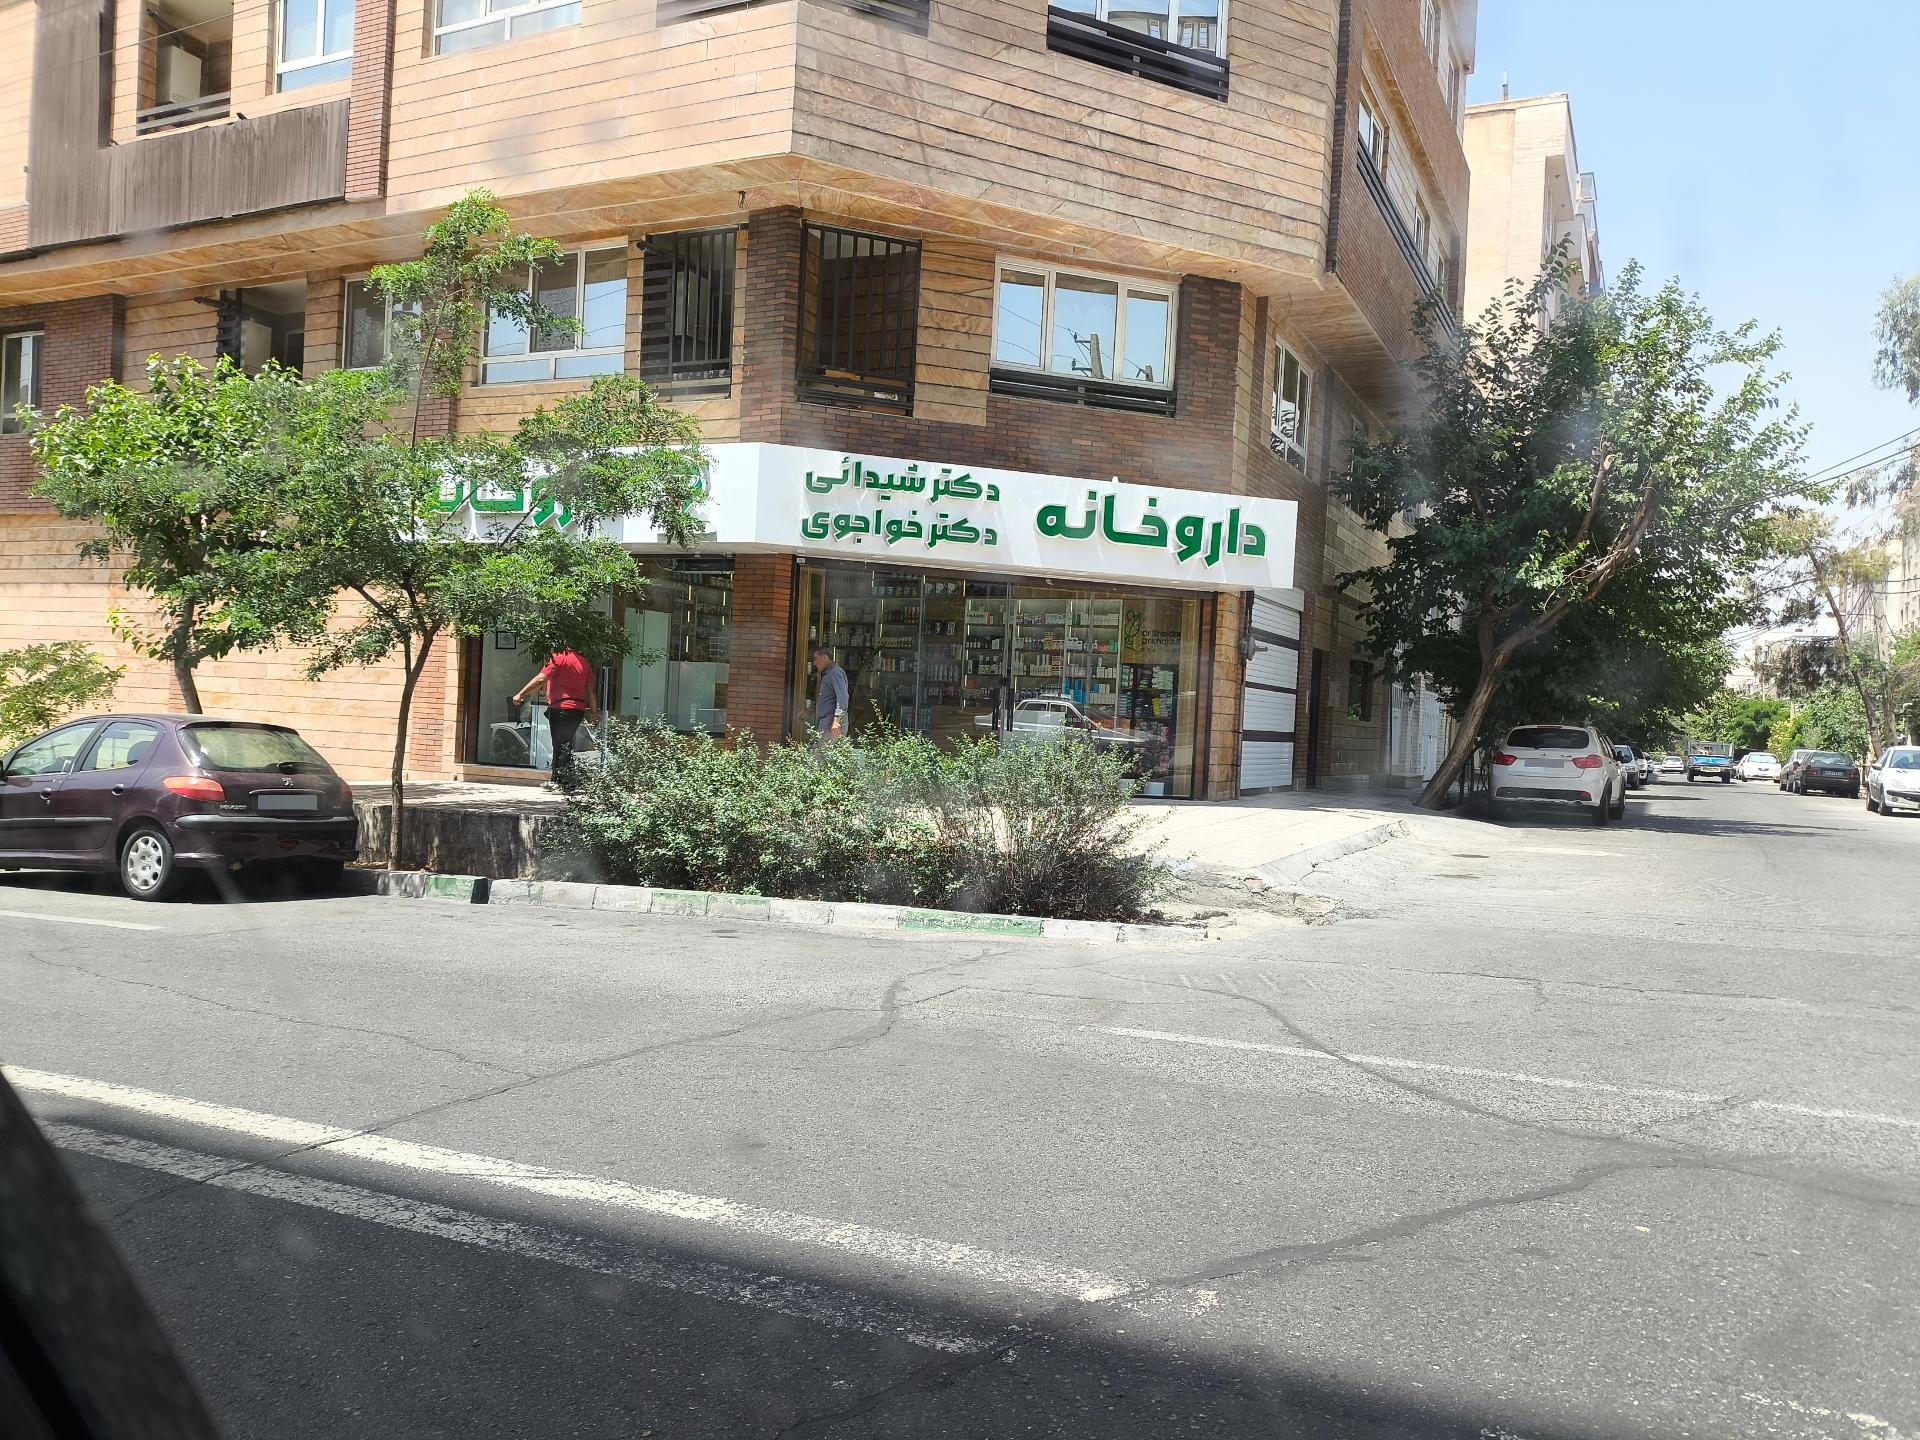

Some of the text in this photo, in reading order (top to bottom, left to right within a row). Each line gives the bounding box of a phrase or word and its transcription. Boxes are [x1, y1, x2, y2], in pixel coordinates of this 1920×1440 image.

[805, 456, 1000, 504] دکتر شیدائی
[801, 509, 998, 549] دکتر خواجوی
[1036, 489, 1267, 568] داروخانه
